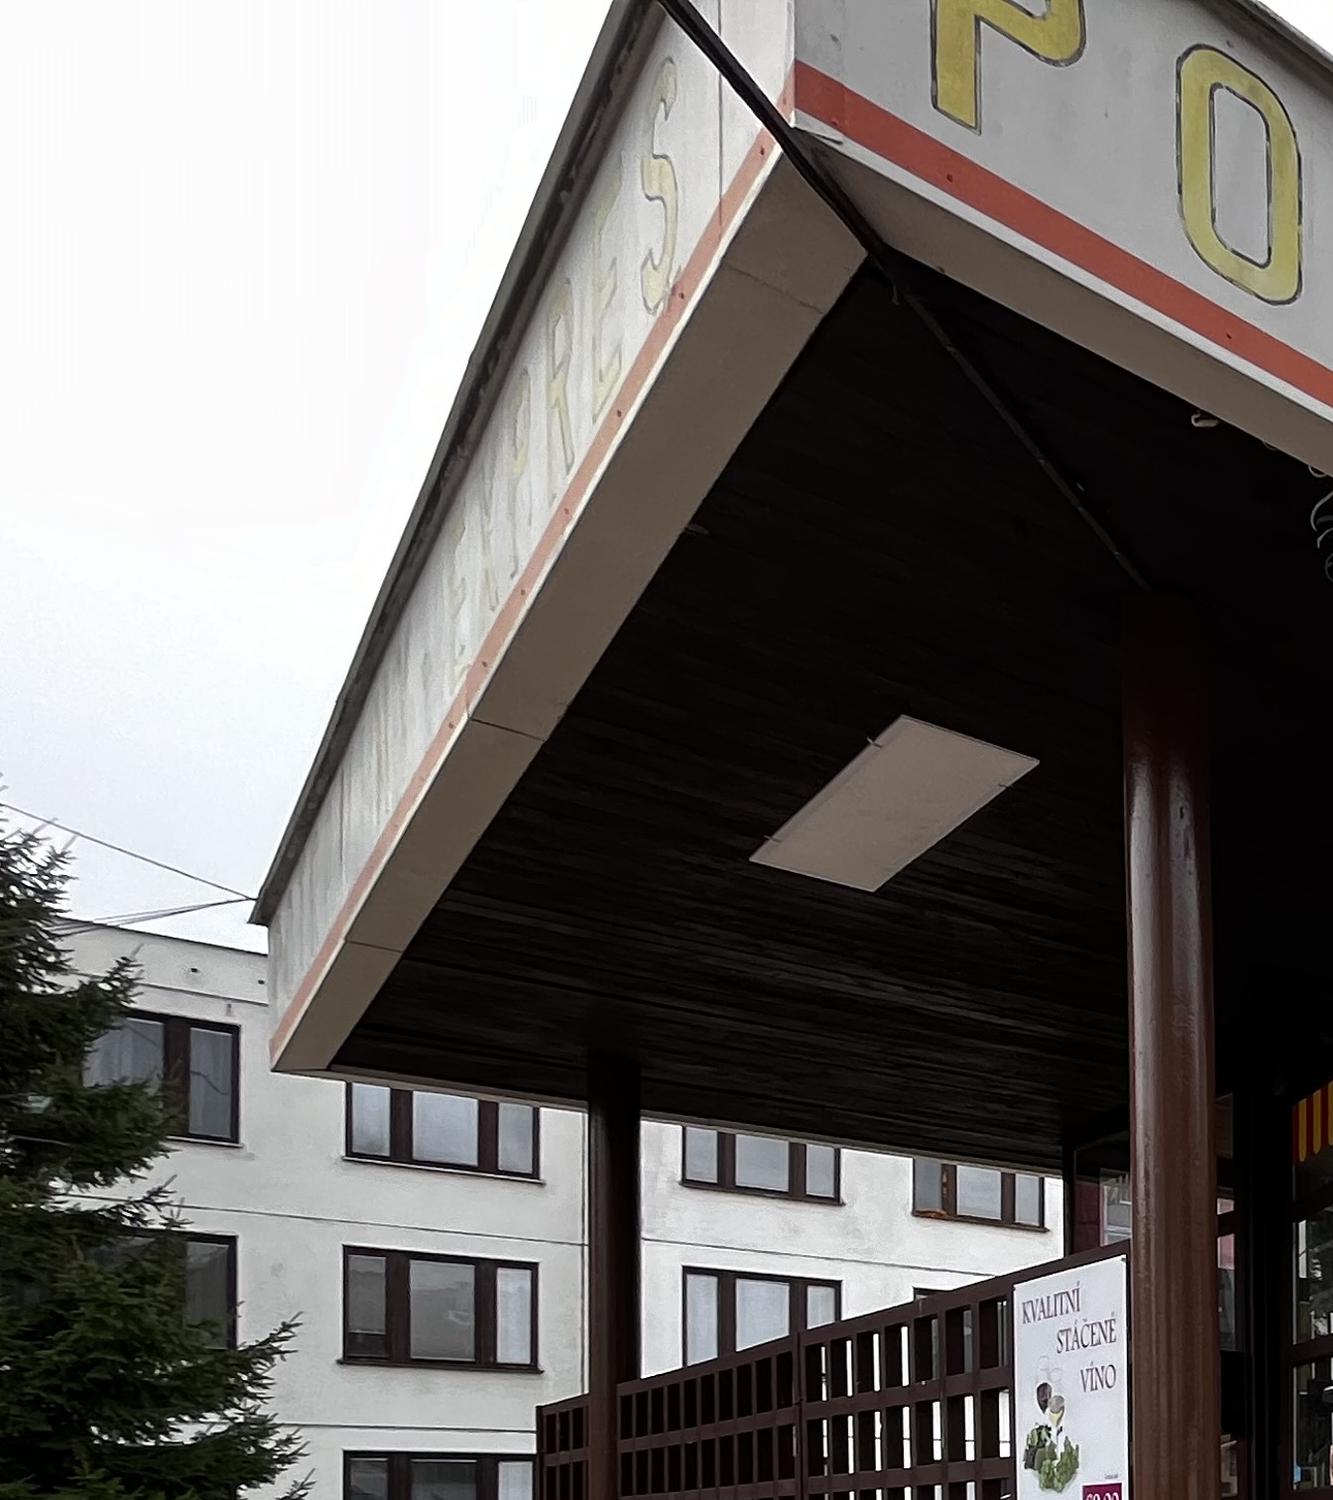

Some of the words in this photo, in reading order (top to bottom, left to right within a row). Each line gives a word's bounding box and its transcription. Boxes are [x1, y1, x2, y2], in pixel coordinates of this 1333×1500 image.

[1021, 1281, 1081, 1325] KVALITNÍ
[1056, 1311, 1117, 1354] STÁČENÉ
[1080, 1361, 1117, 1393] VÍNO
